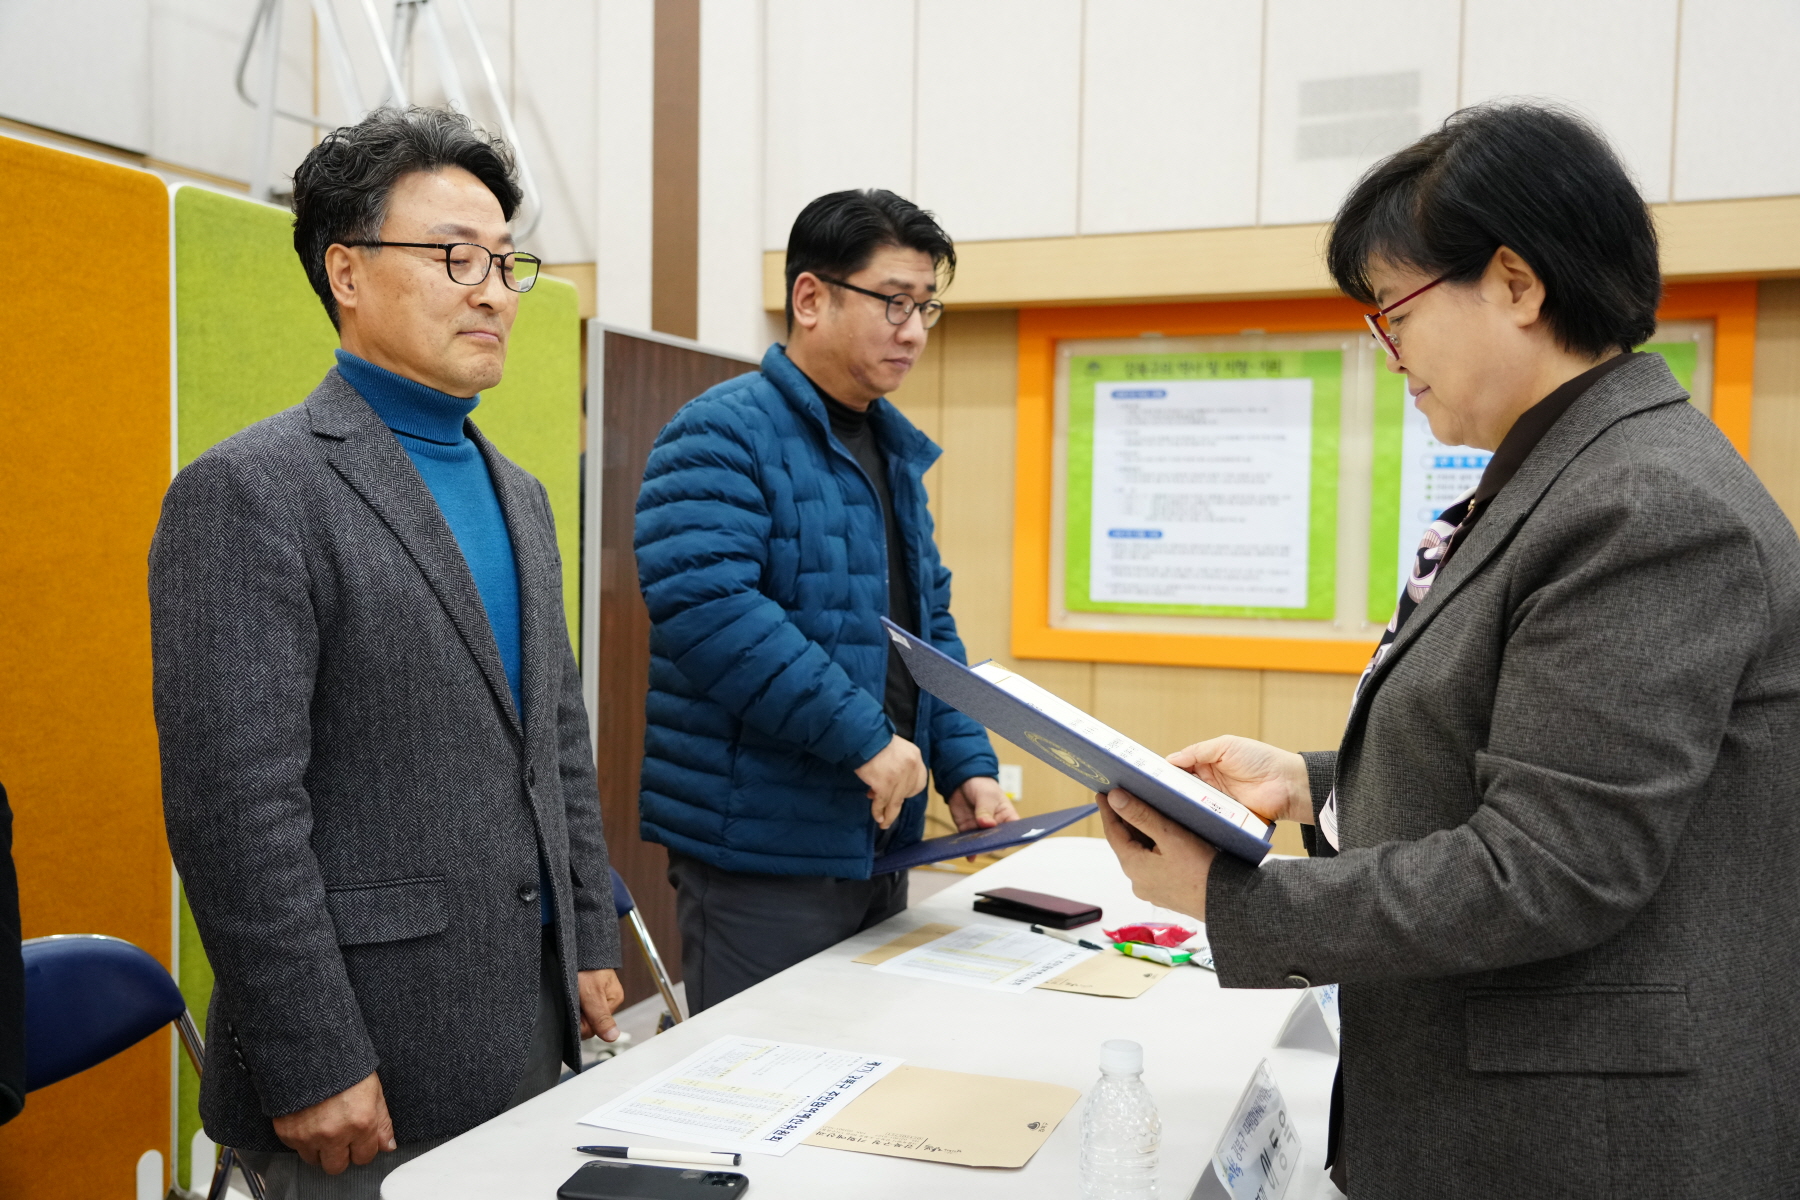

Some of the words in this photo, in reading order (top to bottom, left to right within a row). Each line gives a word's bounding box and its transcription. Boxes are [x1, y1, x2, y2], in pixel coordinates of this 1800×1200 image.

[836, 1074, 863, 1089] 강북구
[764, 1090, 840, 1142] 주민참여예산위원회
[1230, 1131, 1249, 1162] 강북구
